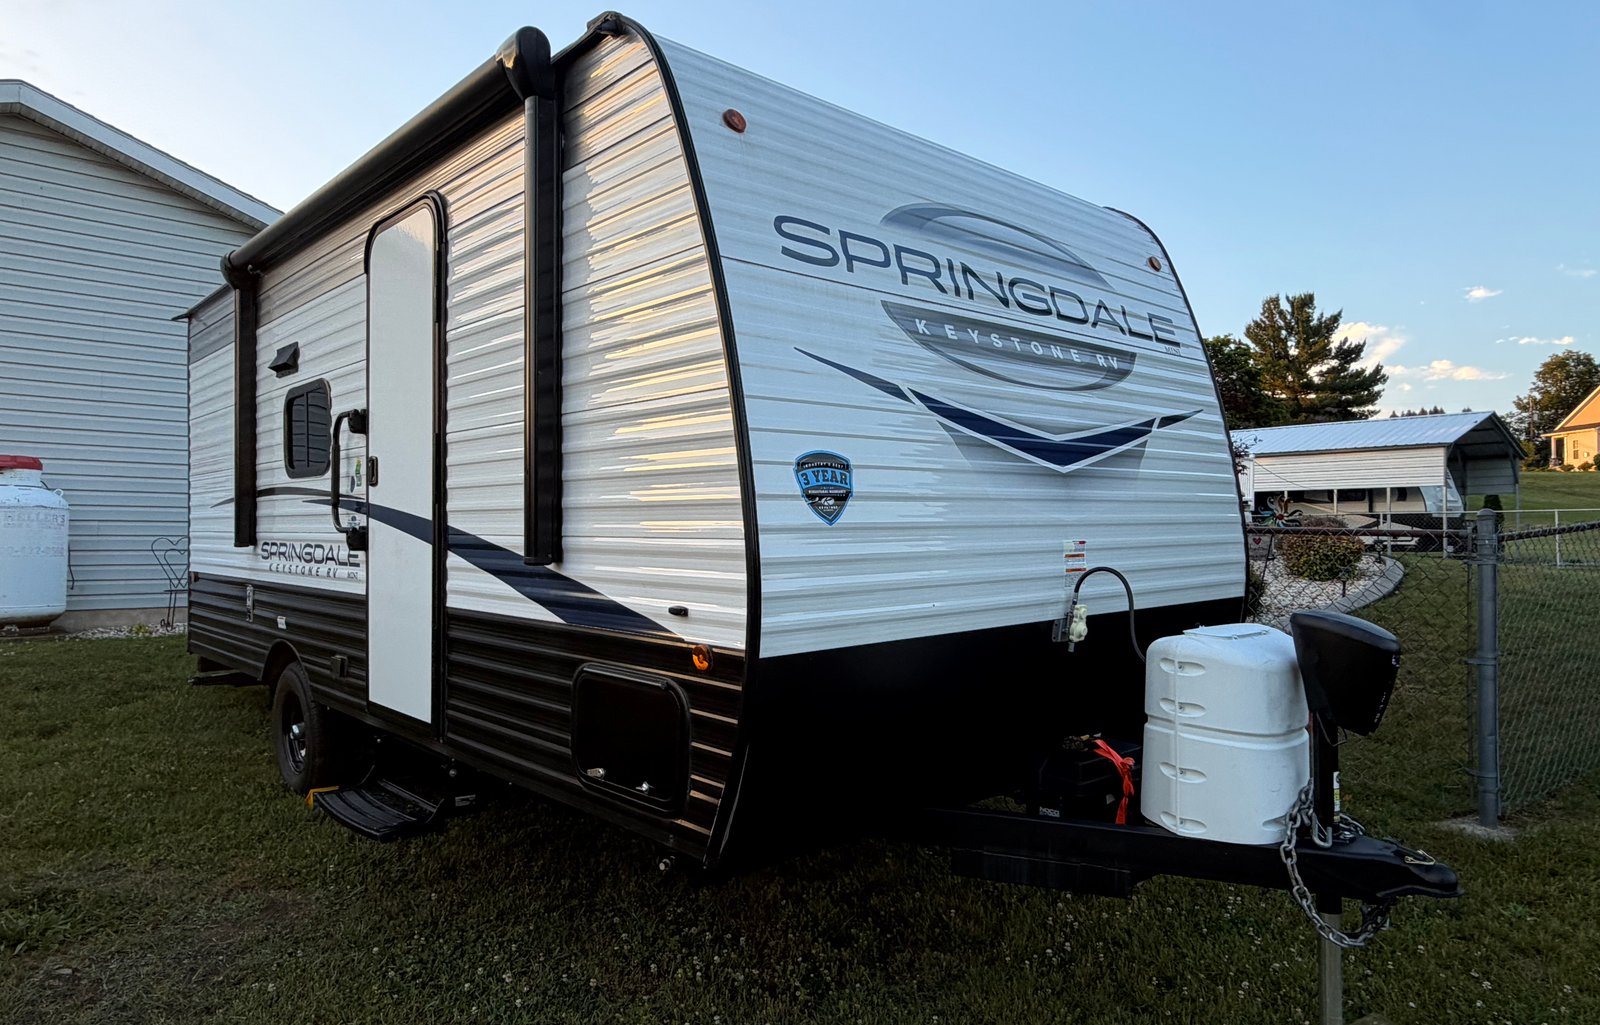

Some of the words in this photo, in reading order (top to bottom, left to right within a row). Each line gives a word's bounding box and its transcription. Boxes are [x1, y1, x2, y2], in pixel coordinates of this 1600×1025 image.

[773, 215, 1182, 348] SPRINGDALE
[915, 318, 1083, 363] KEYSTONE
[1096, 353, 1119, 370] RV
[801, 472, 810, 486] 3
[812, 470, 848, 485] YEAR
[261, 541, 360, 567] SPRINGDALE
[269, 562, 320, 577] KEYSTONE
[327, 567, 338, 578] RV
